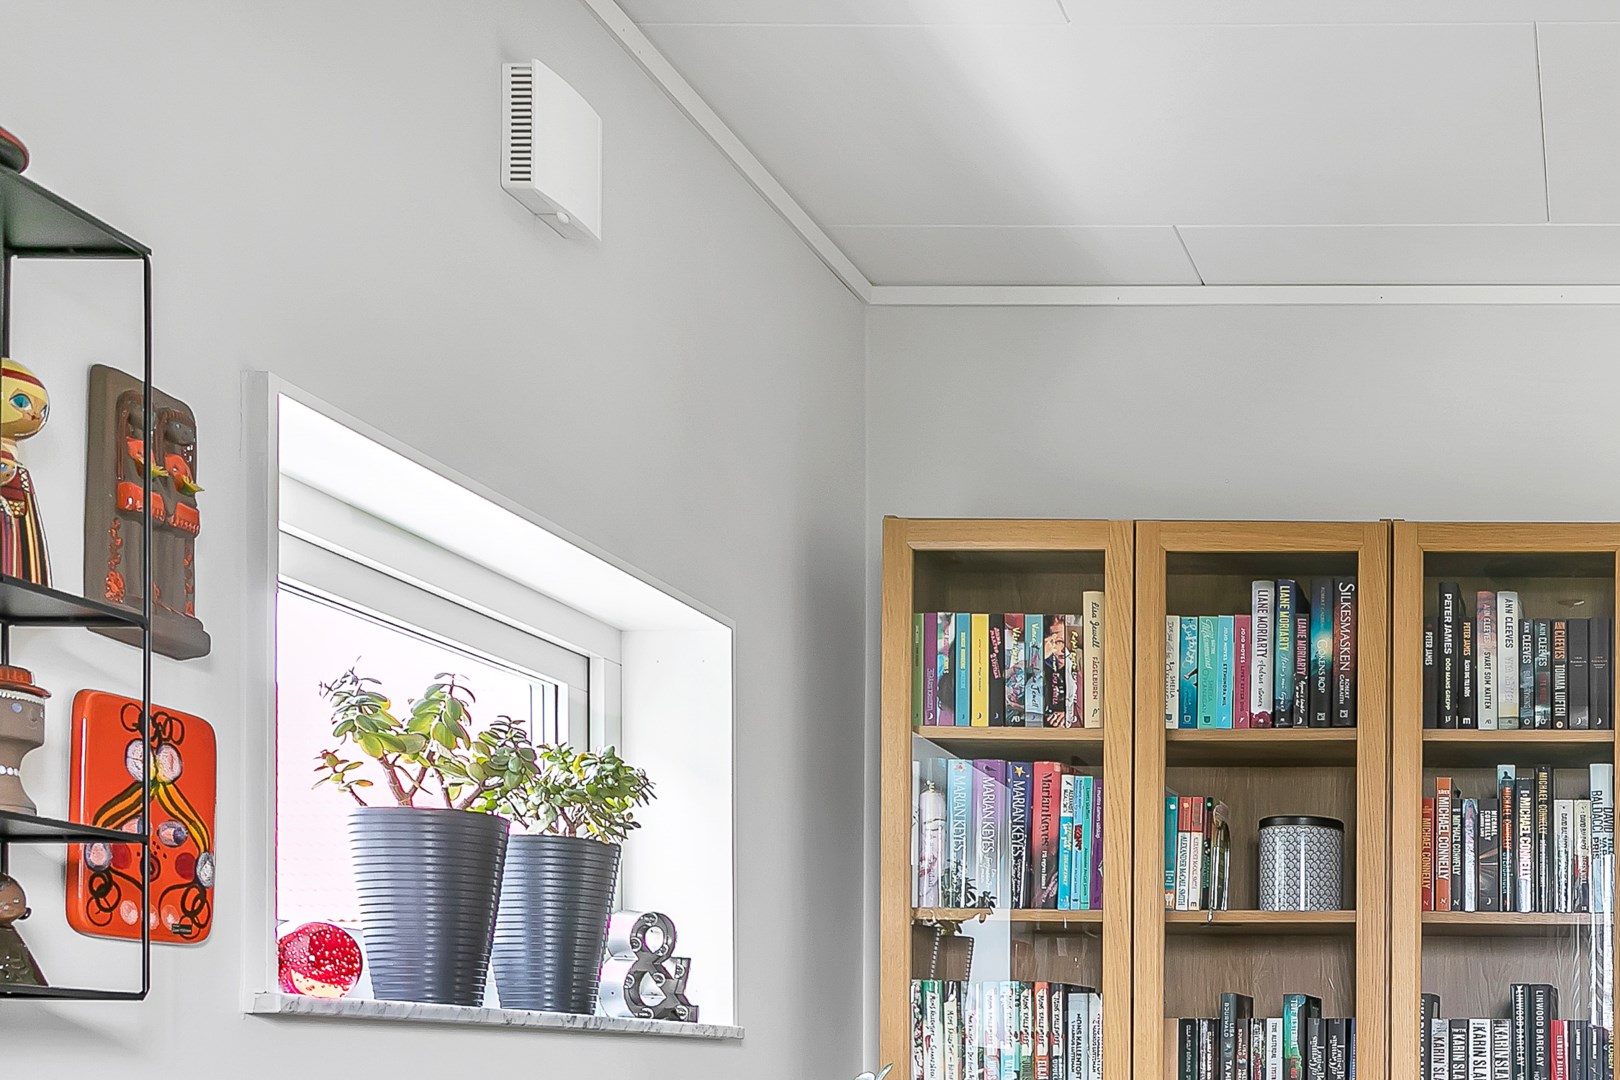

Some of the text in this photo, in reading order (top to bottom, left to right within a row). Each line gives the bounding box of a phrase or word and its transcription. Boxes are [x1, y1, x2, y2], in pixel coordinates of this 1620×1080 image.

[1089, 601, 1101, 649] Lisa Jewell
[1256, 590, 1269, 659] LIANE MORIARTY
[1279, 586, 1291, 652] LIANE MORIARTY
[1338, 582, 1355, 671] SILKESMASKEN
[1444, 593, 1452, 655] PETER JAMES
[1505, 598, 1513, 649] ANN CLEEVES
[1296, 618, 1307, 676] LIANE MORIARTY
[1092, 657, 1100, 700] FÅGELBUREN
[1554, 664, 1564, 690] TOMMA
[953, 775, 967, 819] MARIAN
[982, 776, 995, 854] MARIAN KEYES
[1012, 780, 1025, 856] MARIAN KEYES
[1038, 773, 1053, 847] Marian Keyes
[1591, 790, 1603, 834] BALDACCI
[953, 820, 967, 852] KEYES
[1180, 836, 1188, 868] ALEXANDER
[1422, 818, 1431, 889] MICHAEL CONNELLY
[1438, 797, 1449, 880] MICHAEL CONNELLY
[1519, 797, 1532, 880] MICHAEL CONNELLY
[1432, 1037, 1445, 1064] KARIN
[1452, 1034, 1465, 1061] KARIN
[1472, 1026, 1486, 1058] KARIN
[1494, 1026, 1509, 1059] KARIN
[1536, 990, 1545, 1067] LINWOOD BARCLAY
[1224, 1060, 1232, 1069] TA
